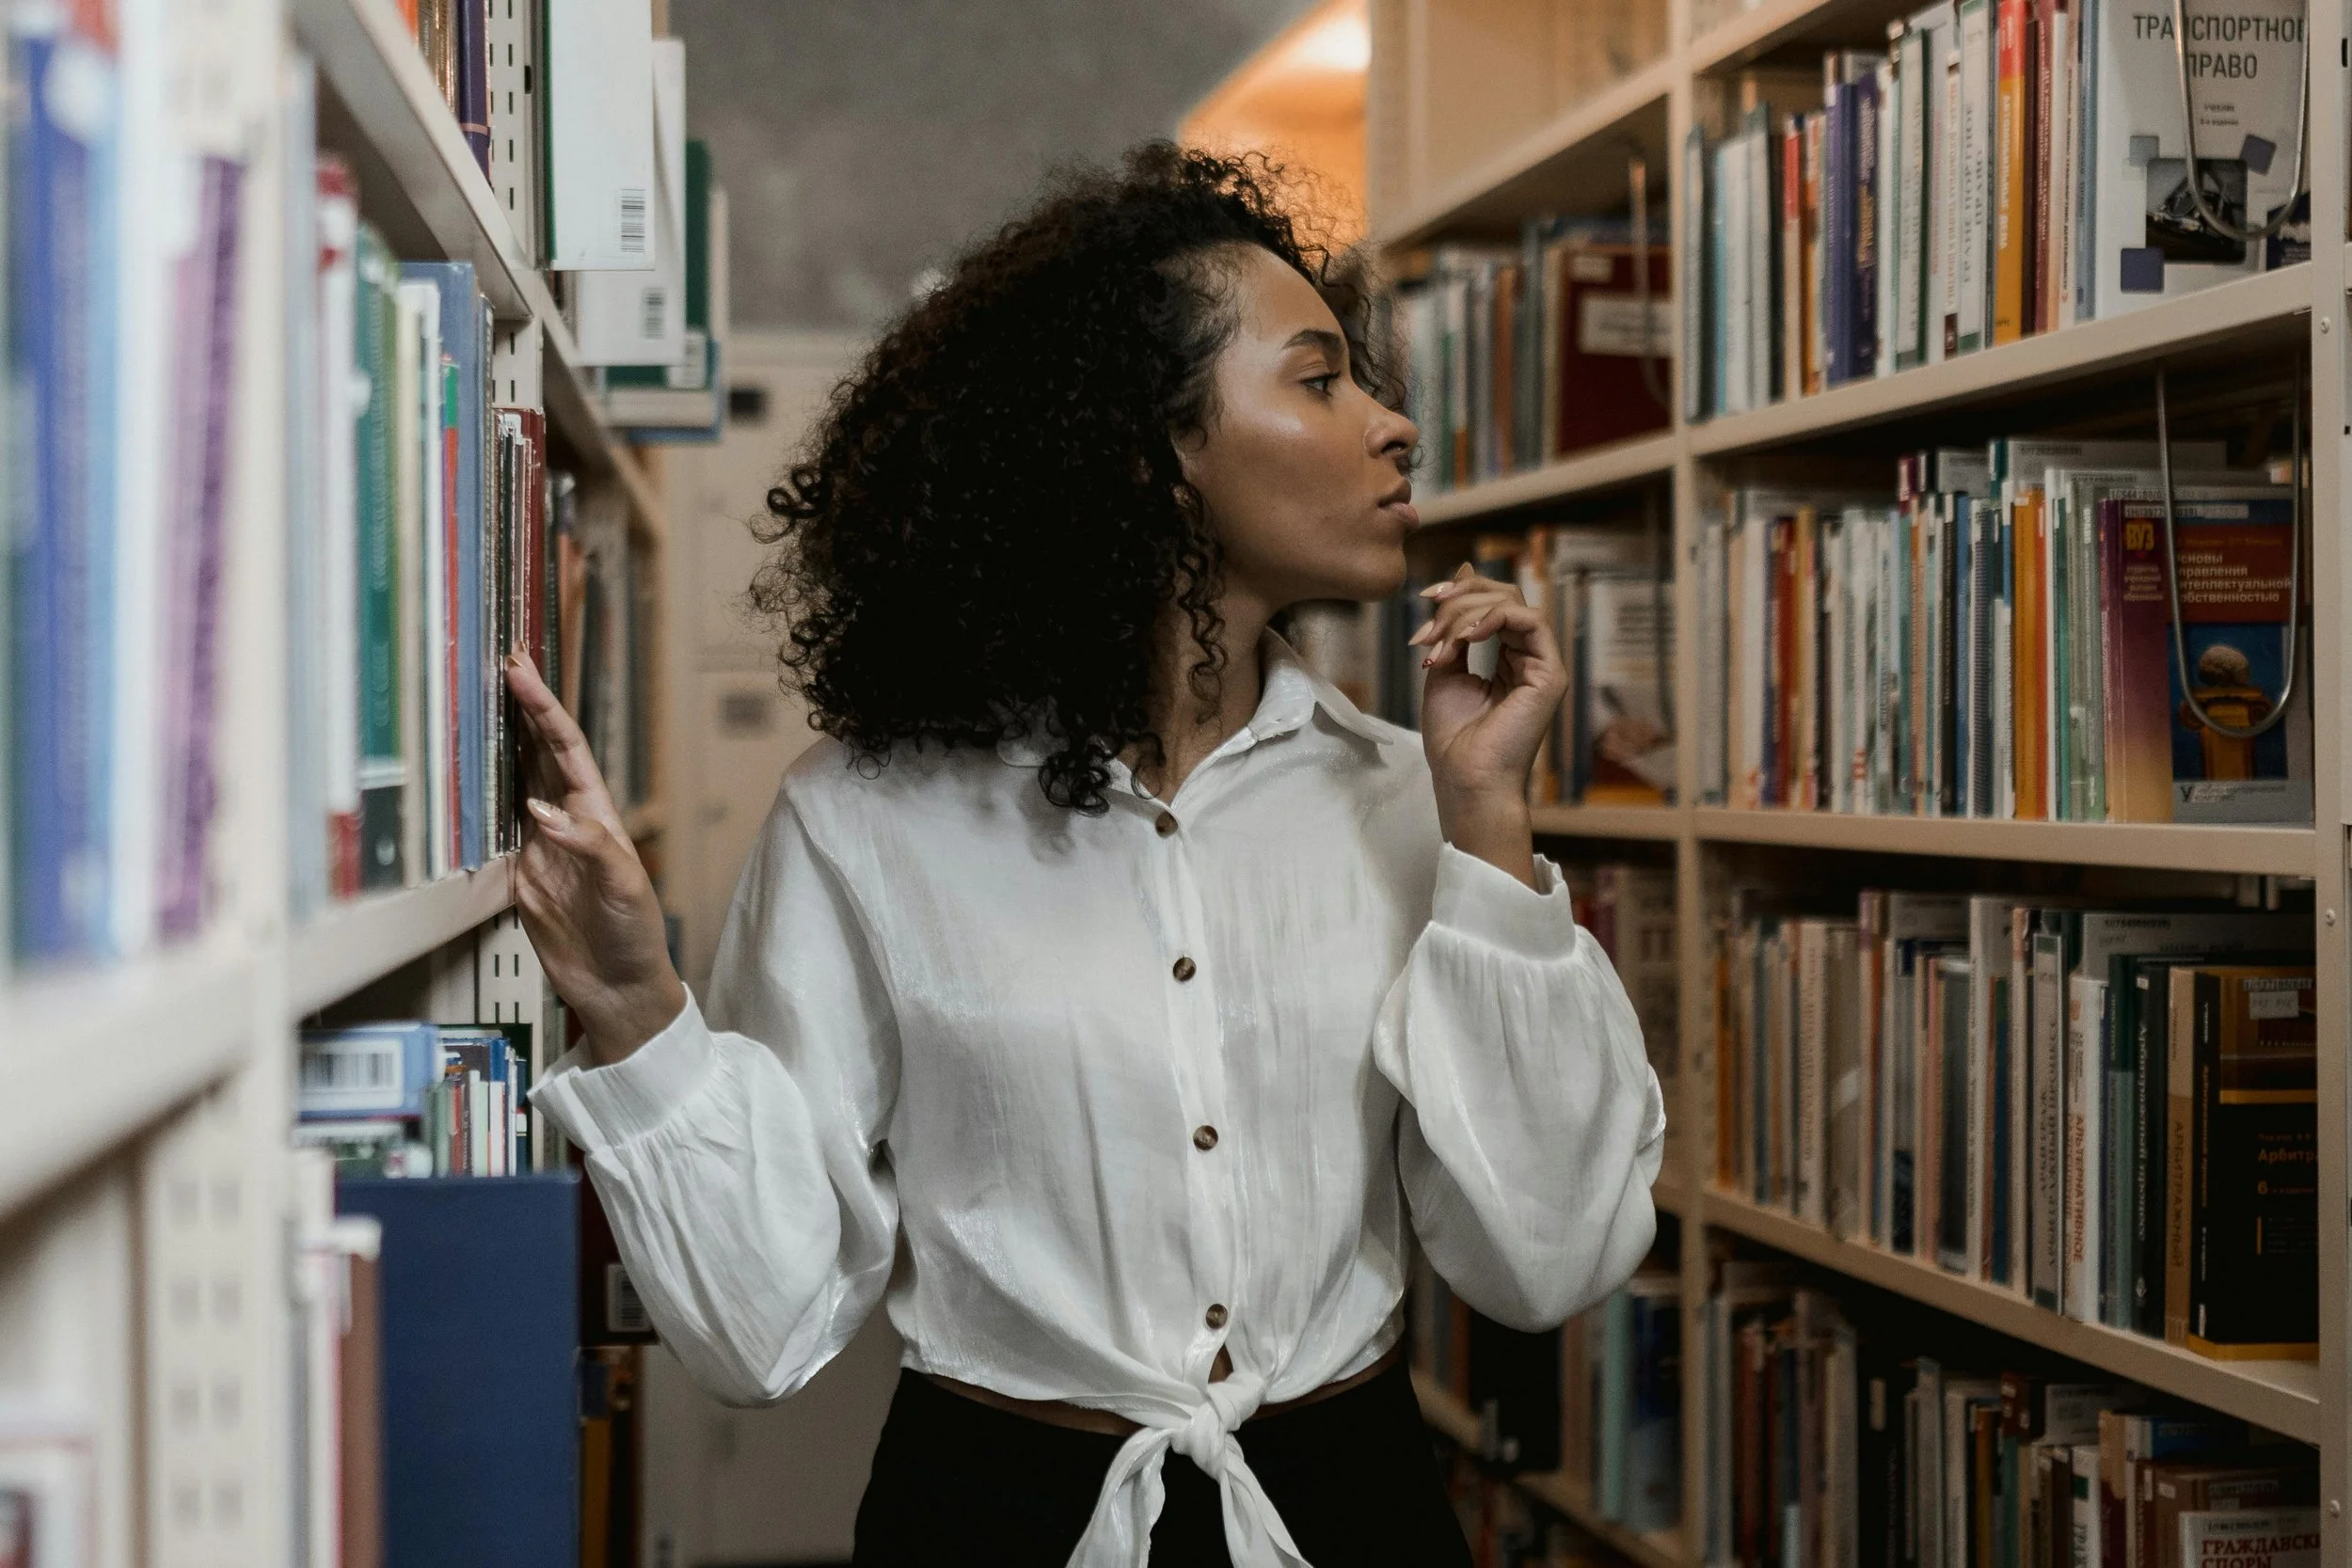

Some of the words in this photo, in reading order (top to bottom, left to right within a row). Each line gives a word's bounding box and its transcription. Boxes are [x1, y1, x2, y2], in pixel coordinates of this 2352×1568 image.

[2125, 521, 2154, 550] ВУЗ
[2177, 553, 2223, 565] сновы
[2178, 566, 2249, 579] правления
[2179, 578, 2292, 592] нтеллектуальной
[2180, 592, 2280, 603] обственностью
[2137, 1022, 2148, 1160] Арбитражный
[2074, 1114, 2085, 1263] АЛЬТЕРНАТИВНОЕ
[2172, 1121, 2184, 1267] АРБИТРАЖНЫЙ
